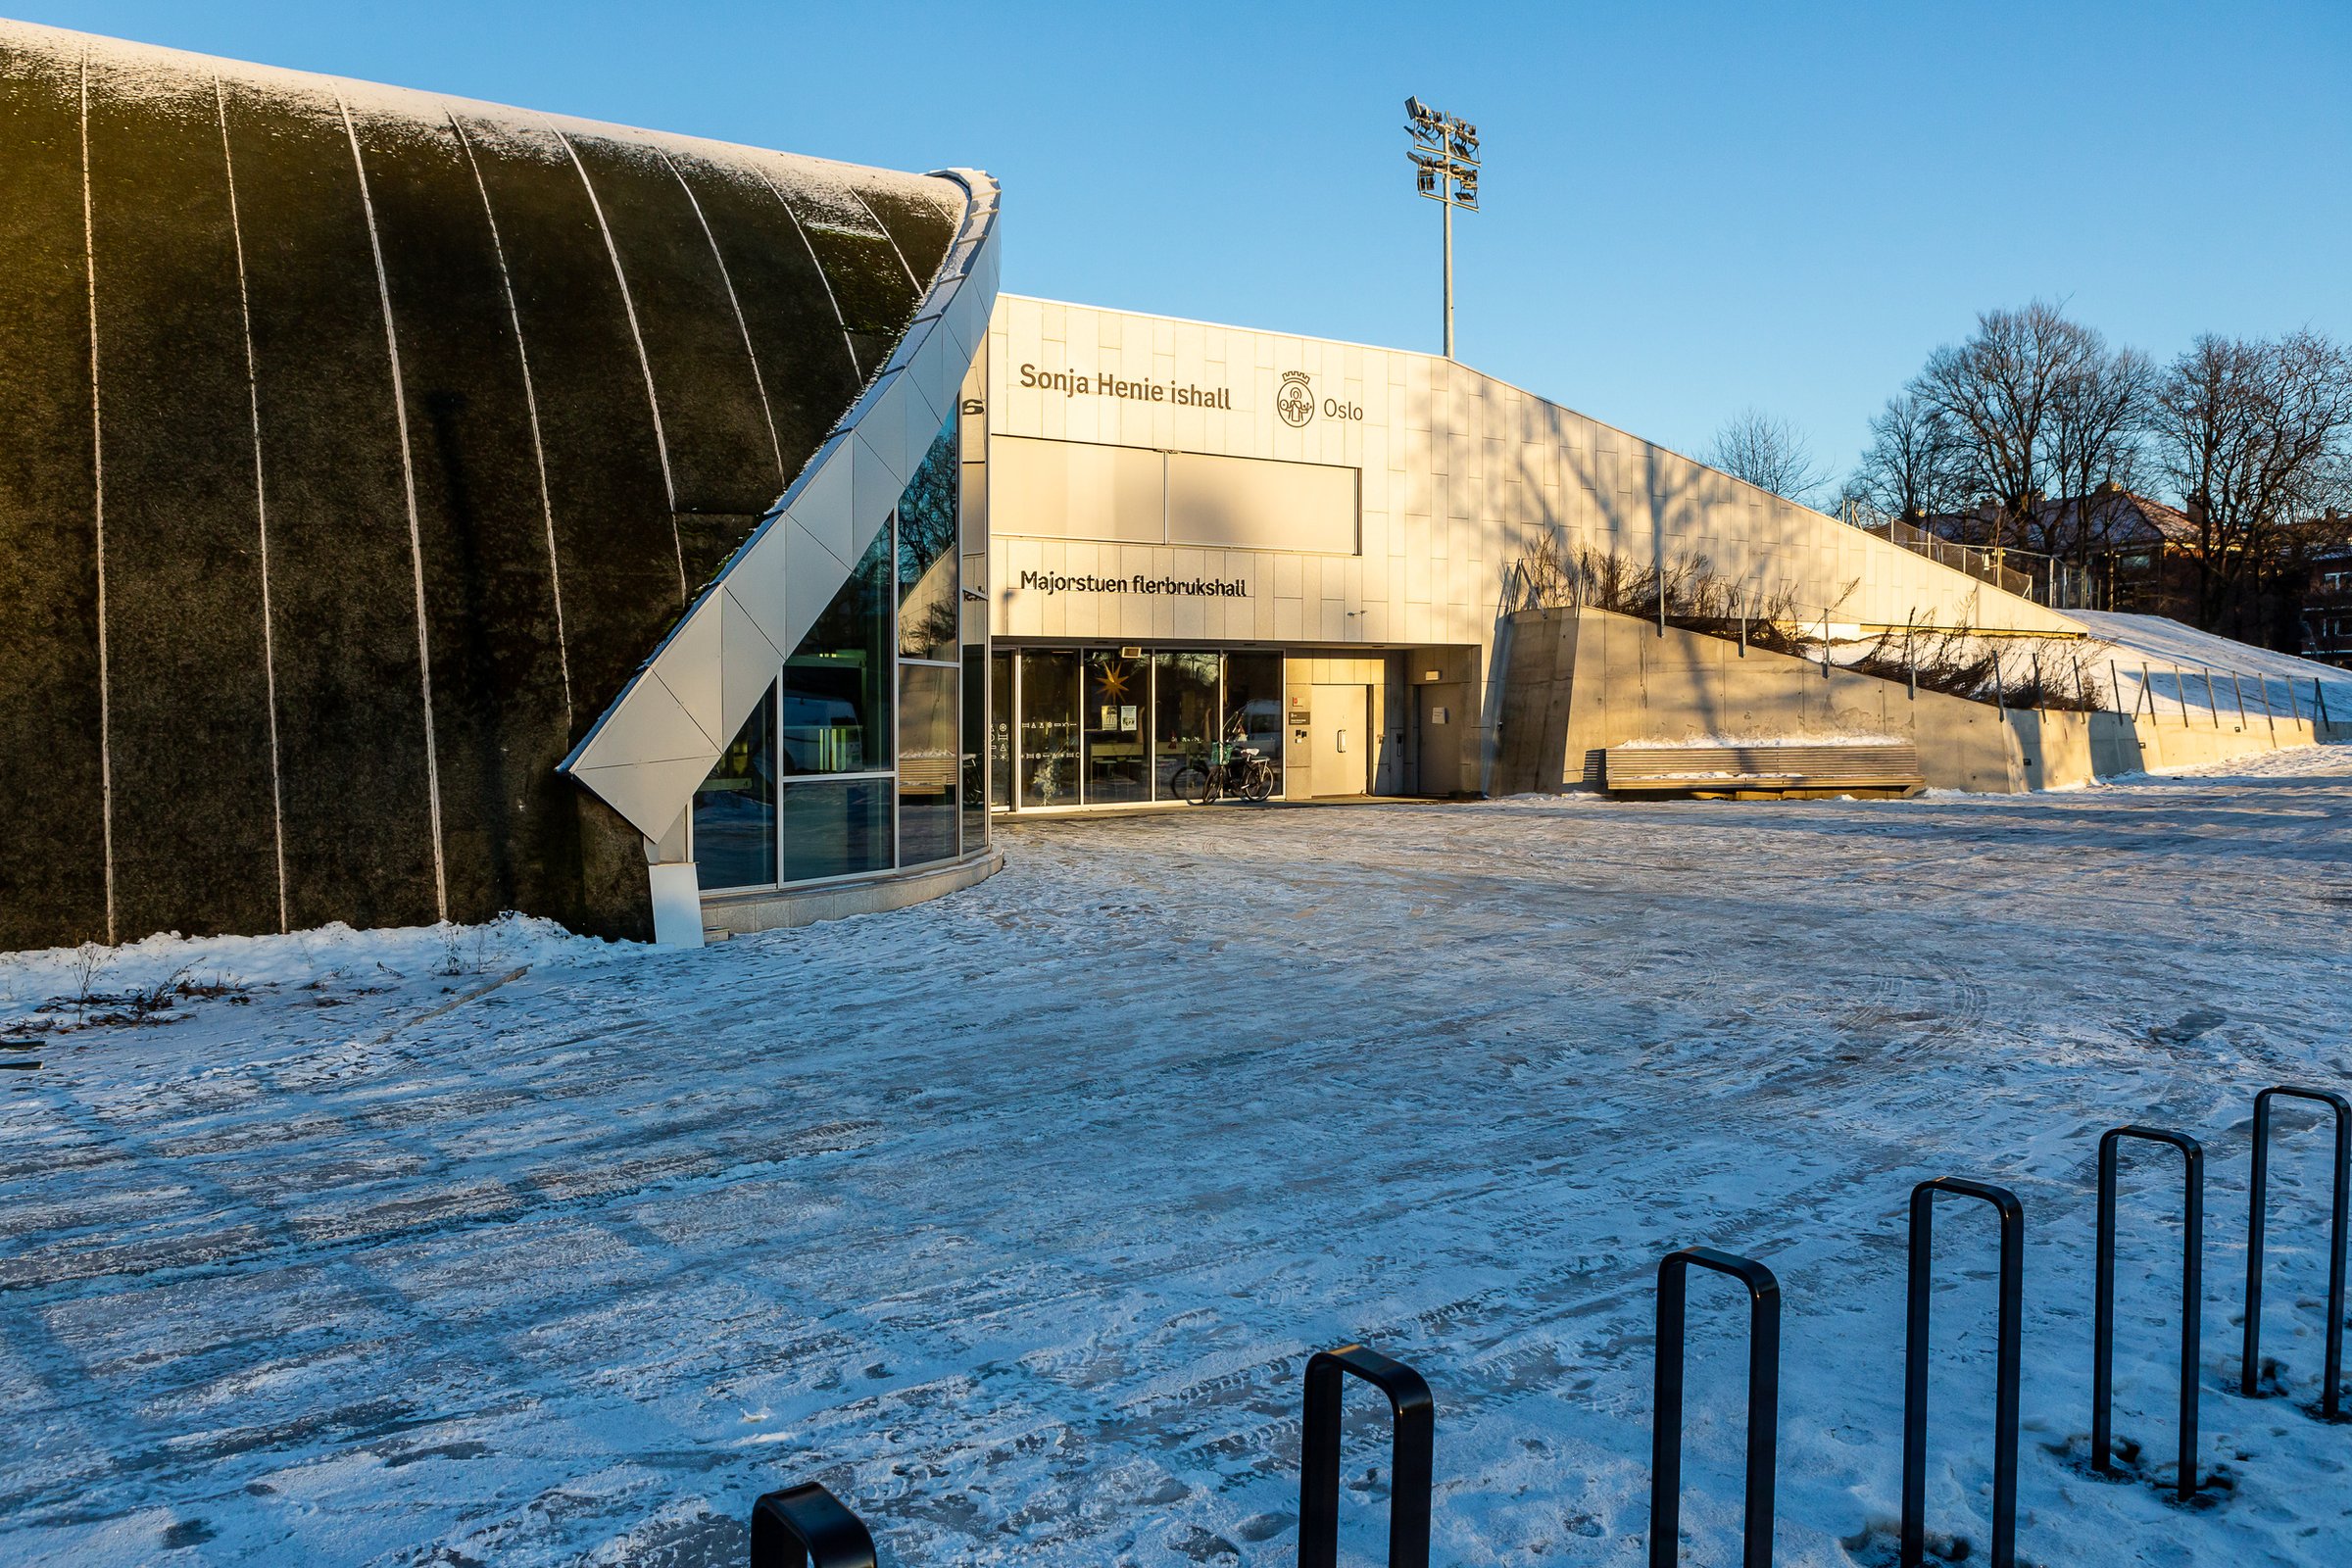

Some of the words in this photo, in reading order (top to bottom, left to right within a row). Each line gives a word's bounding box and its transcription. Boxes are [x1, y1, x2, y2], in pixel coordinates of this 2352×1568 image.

[1019, 363, 1090, 398] Sonja
[1098, 372, 1164, 402] Henie
[1170, 379, 1232, 411] ishall
[1323, 398, 1363, 421] Oslo
[1020, 570, 1128, 596] Majorstuen
[1132, 574, 1248, 598] flerbrukshall
